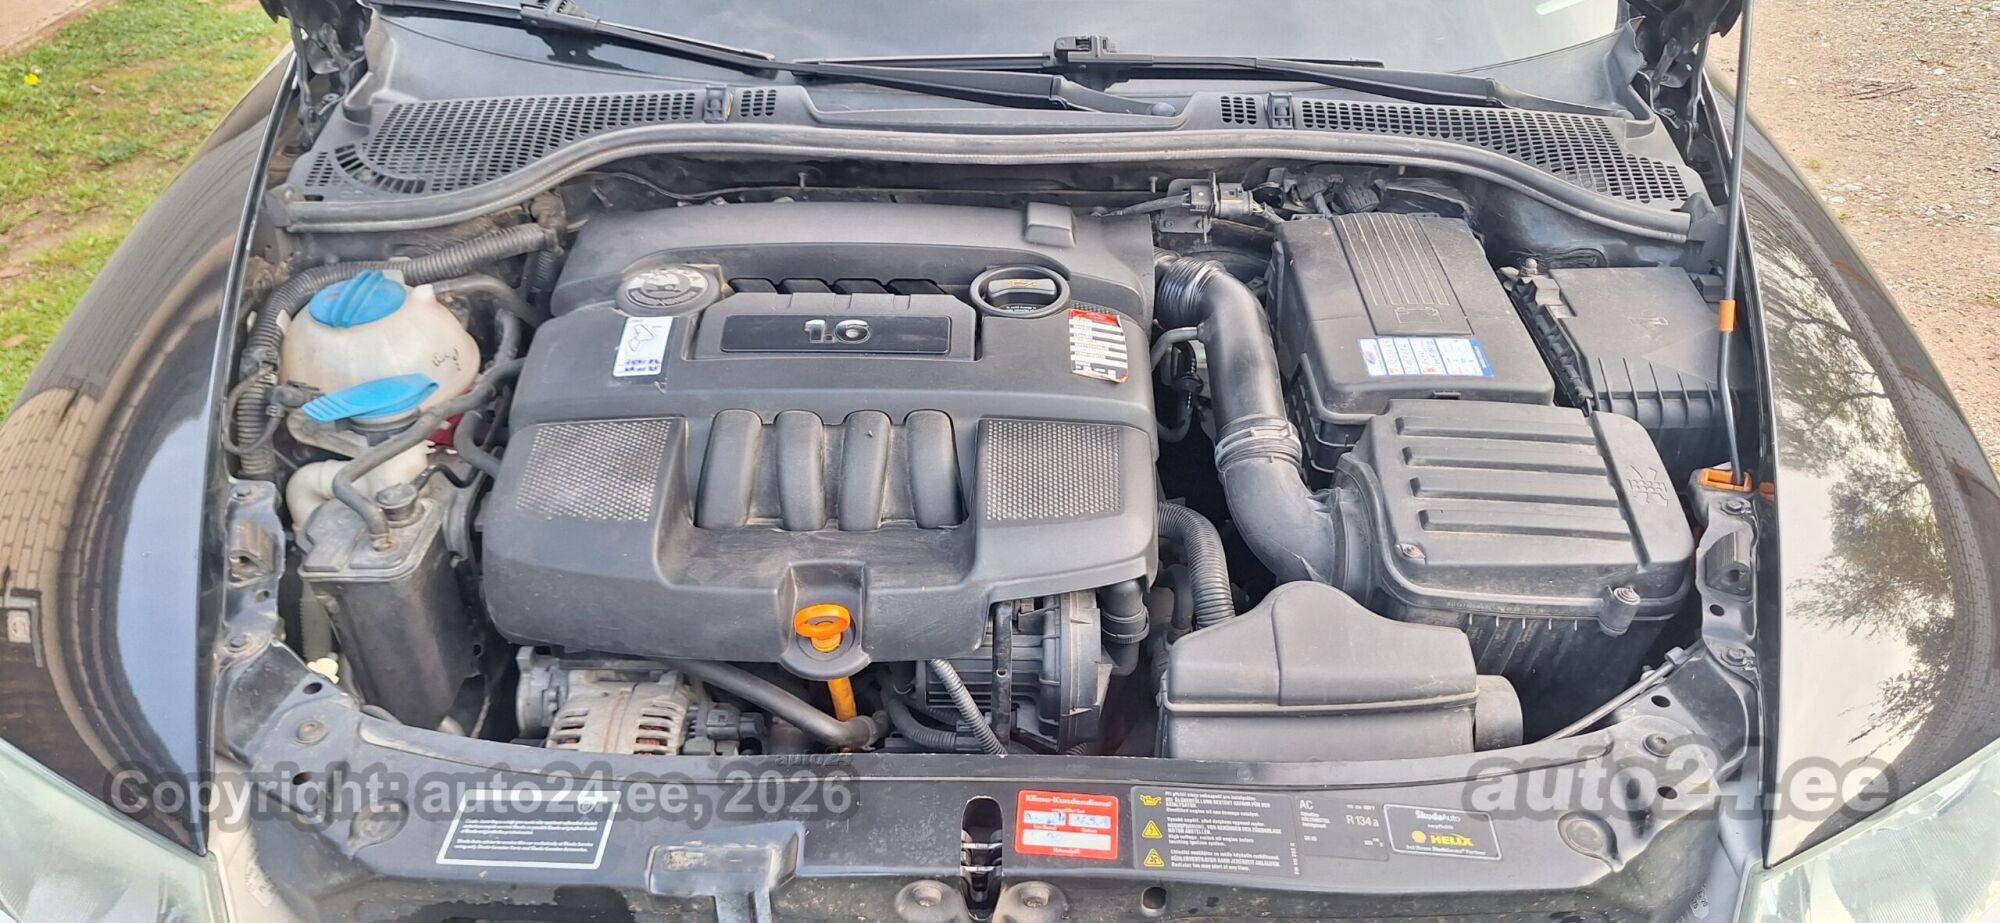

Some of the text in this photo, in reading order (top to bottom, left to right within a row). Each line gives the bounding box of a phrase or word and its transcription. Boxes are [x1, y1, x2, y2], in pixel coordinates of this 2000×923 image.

[804, 319, 871, 344] 1.6
[1300, 800, 1314, 810] AC
[1431, 834, 1474, 847] HELIX
